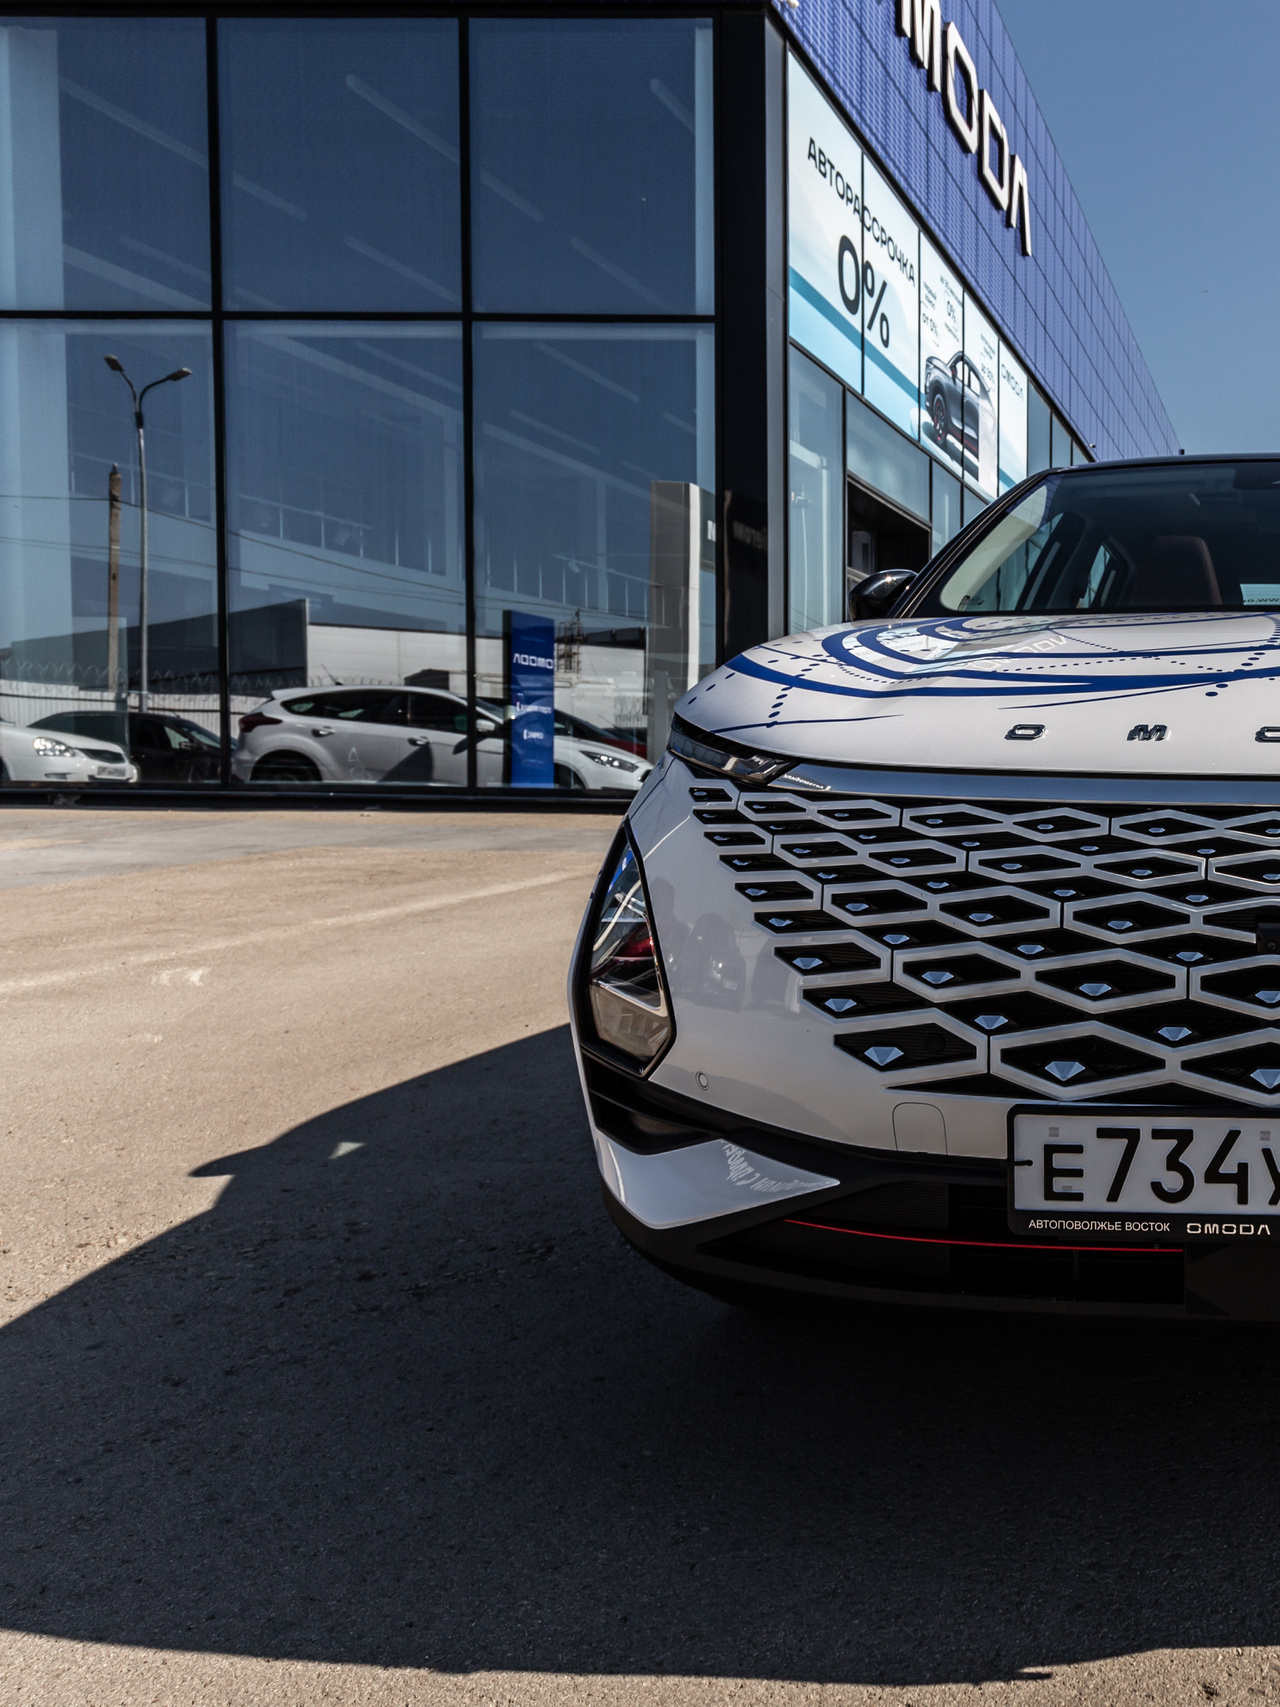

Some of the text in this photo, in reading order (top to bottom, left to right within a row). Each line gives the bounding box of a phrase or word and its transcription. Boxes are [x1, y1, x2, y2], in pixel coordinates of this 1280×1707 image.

[807, 136, 916, 287] АВТОРАССРОЧКА
[838, 234, 890, 349] 0%
[1029, 1219, 1122, 1231] АВТОПОВОЛЖЬЕ
[1125, 1221, 1171, 1232] ВОСТОК
[1186, 1222, 1271, 1236] OMODA
